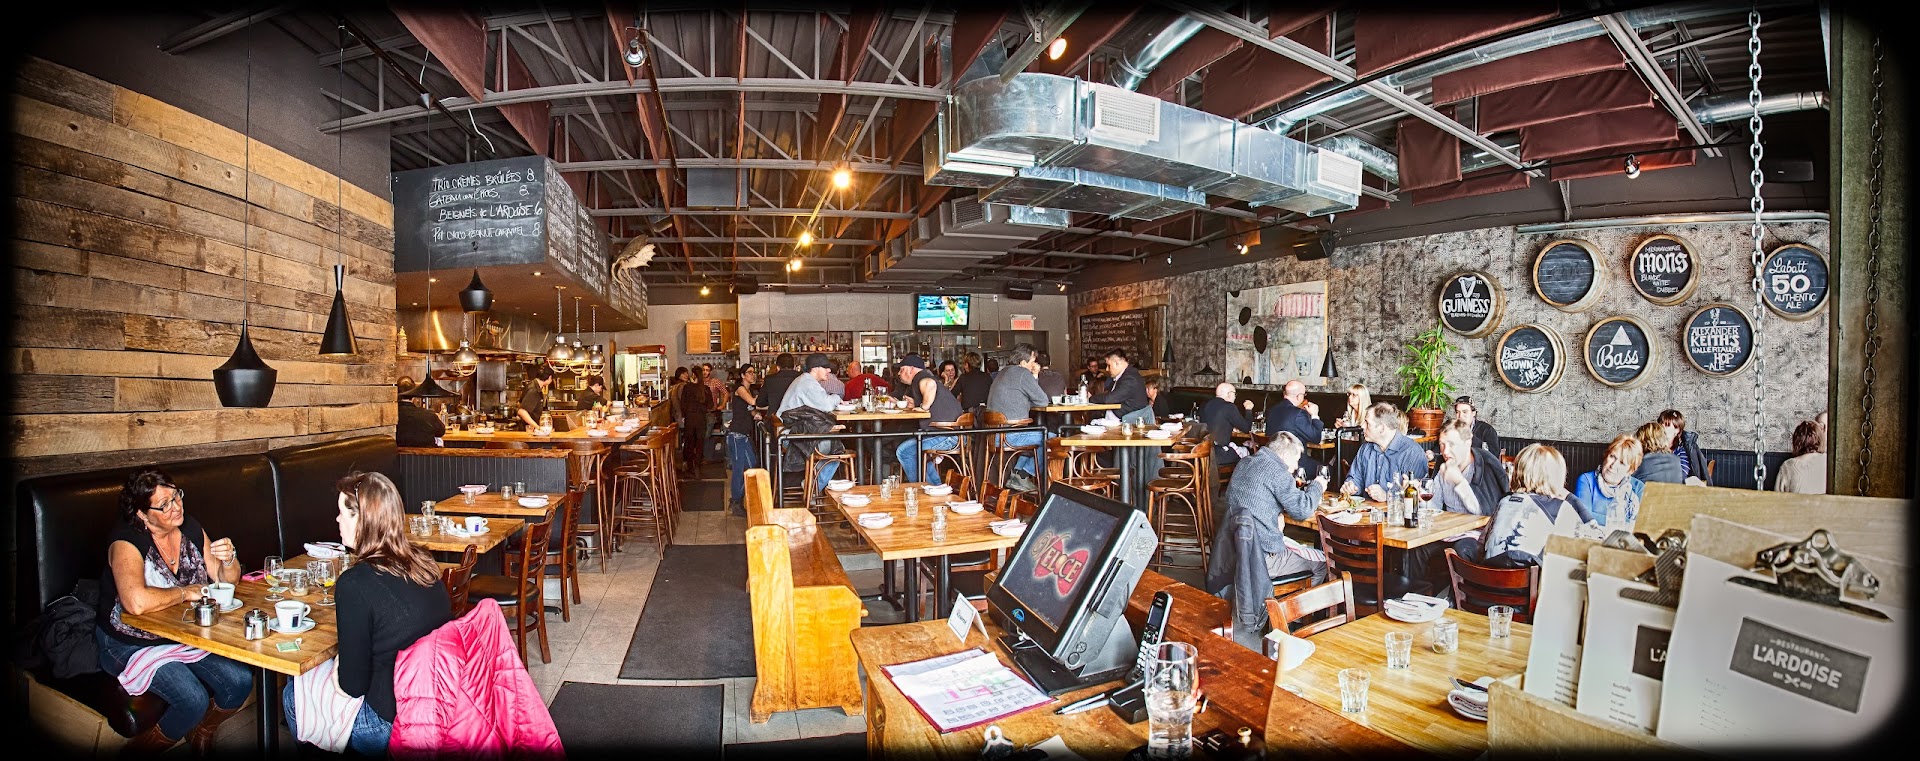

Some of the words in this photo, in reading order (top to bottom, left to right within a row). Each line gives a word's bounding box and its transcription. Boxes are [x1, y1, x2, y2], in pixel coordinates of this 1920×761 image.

[432, 176, 450, 191] TRIO
[1768, 257, 1809, 274] Labatt
[1772, 274, 1811, 294] 50
[1774, 293, 1817, 302] AUTHENTIC
[1442, 298, 1490, 314] GUINNESS
[1785, 301, 1803, 309] ALE
[1691, 327, 1739, 336] ALEXANDER
[1690, 334, 1740, 347] KEITH'S
[1596, 344, 1639, 369] Bass
[1713, 353, 1735, 364] HOP
[1502, 360, 1534, 370] CROWN
[1524, 361, 1545, 382] NEW
[1709, 362, 1726, 371] ALE
[1752, 644, 1843, 689] L'ARDOISE
